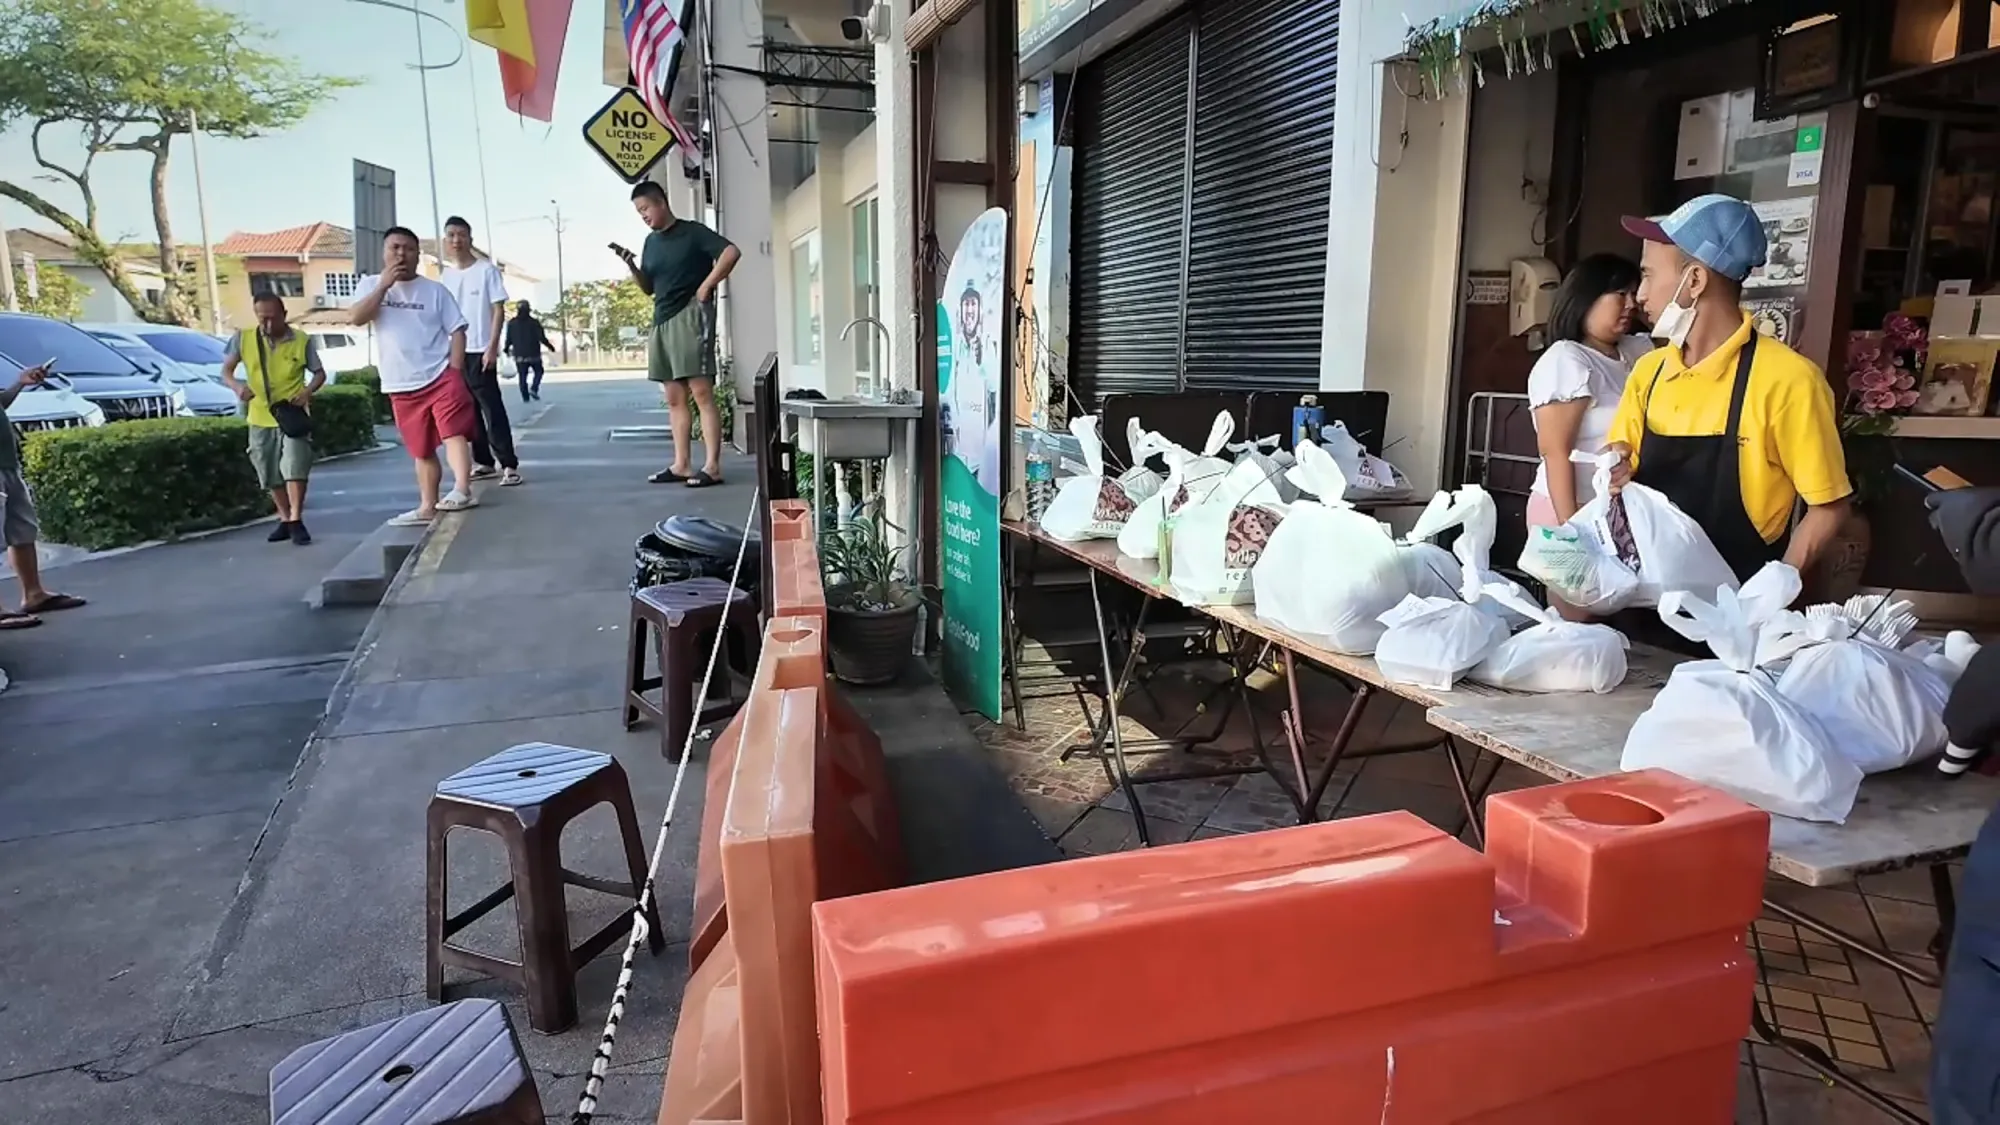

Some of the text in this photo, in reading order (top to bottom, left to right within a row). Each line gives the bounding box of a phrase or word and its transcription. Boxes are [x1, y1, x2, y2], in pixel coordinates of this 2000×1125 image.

[612, 109, 648, 129] NO
[605, 129, 656, 141] LICENSE
[621, 141, 643, 152] NO
[616, 153, 645, 161] ROAD
[621, 161, 640, 169] TAX
[946, 517, 981, 547] food here?
